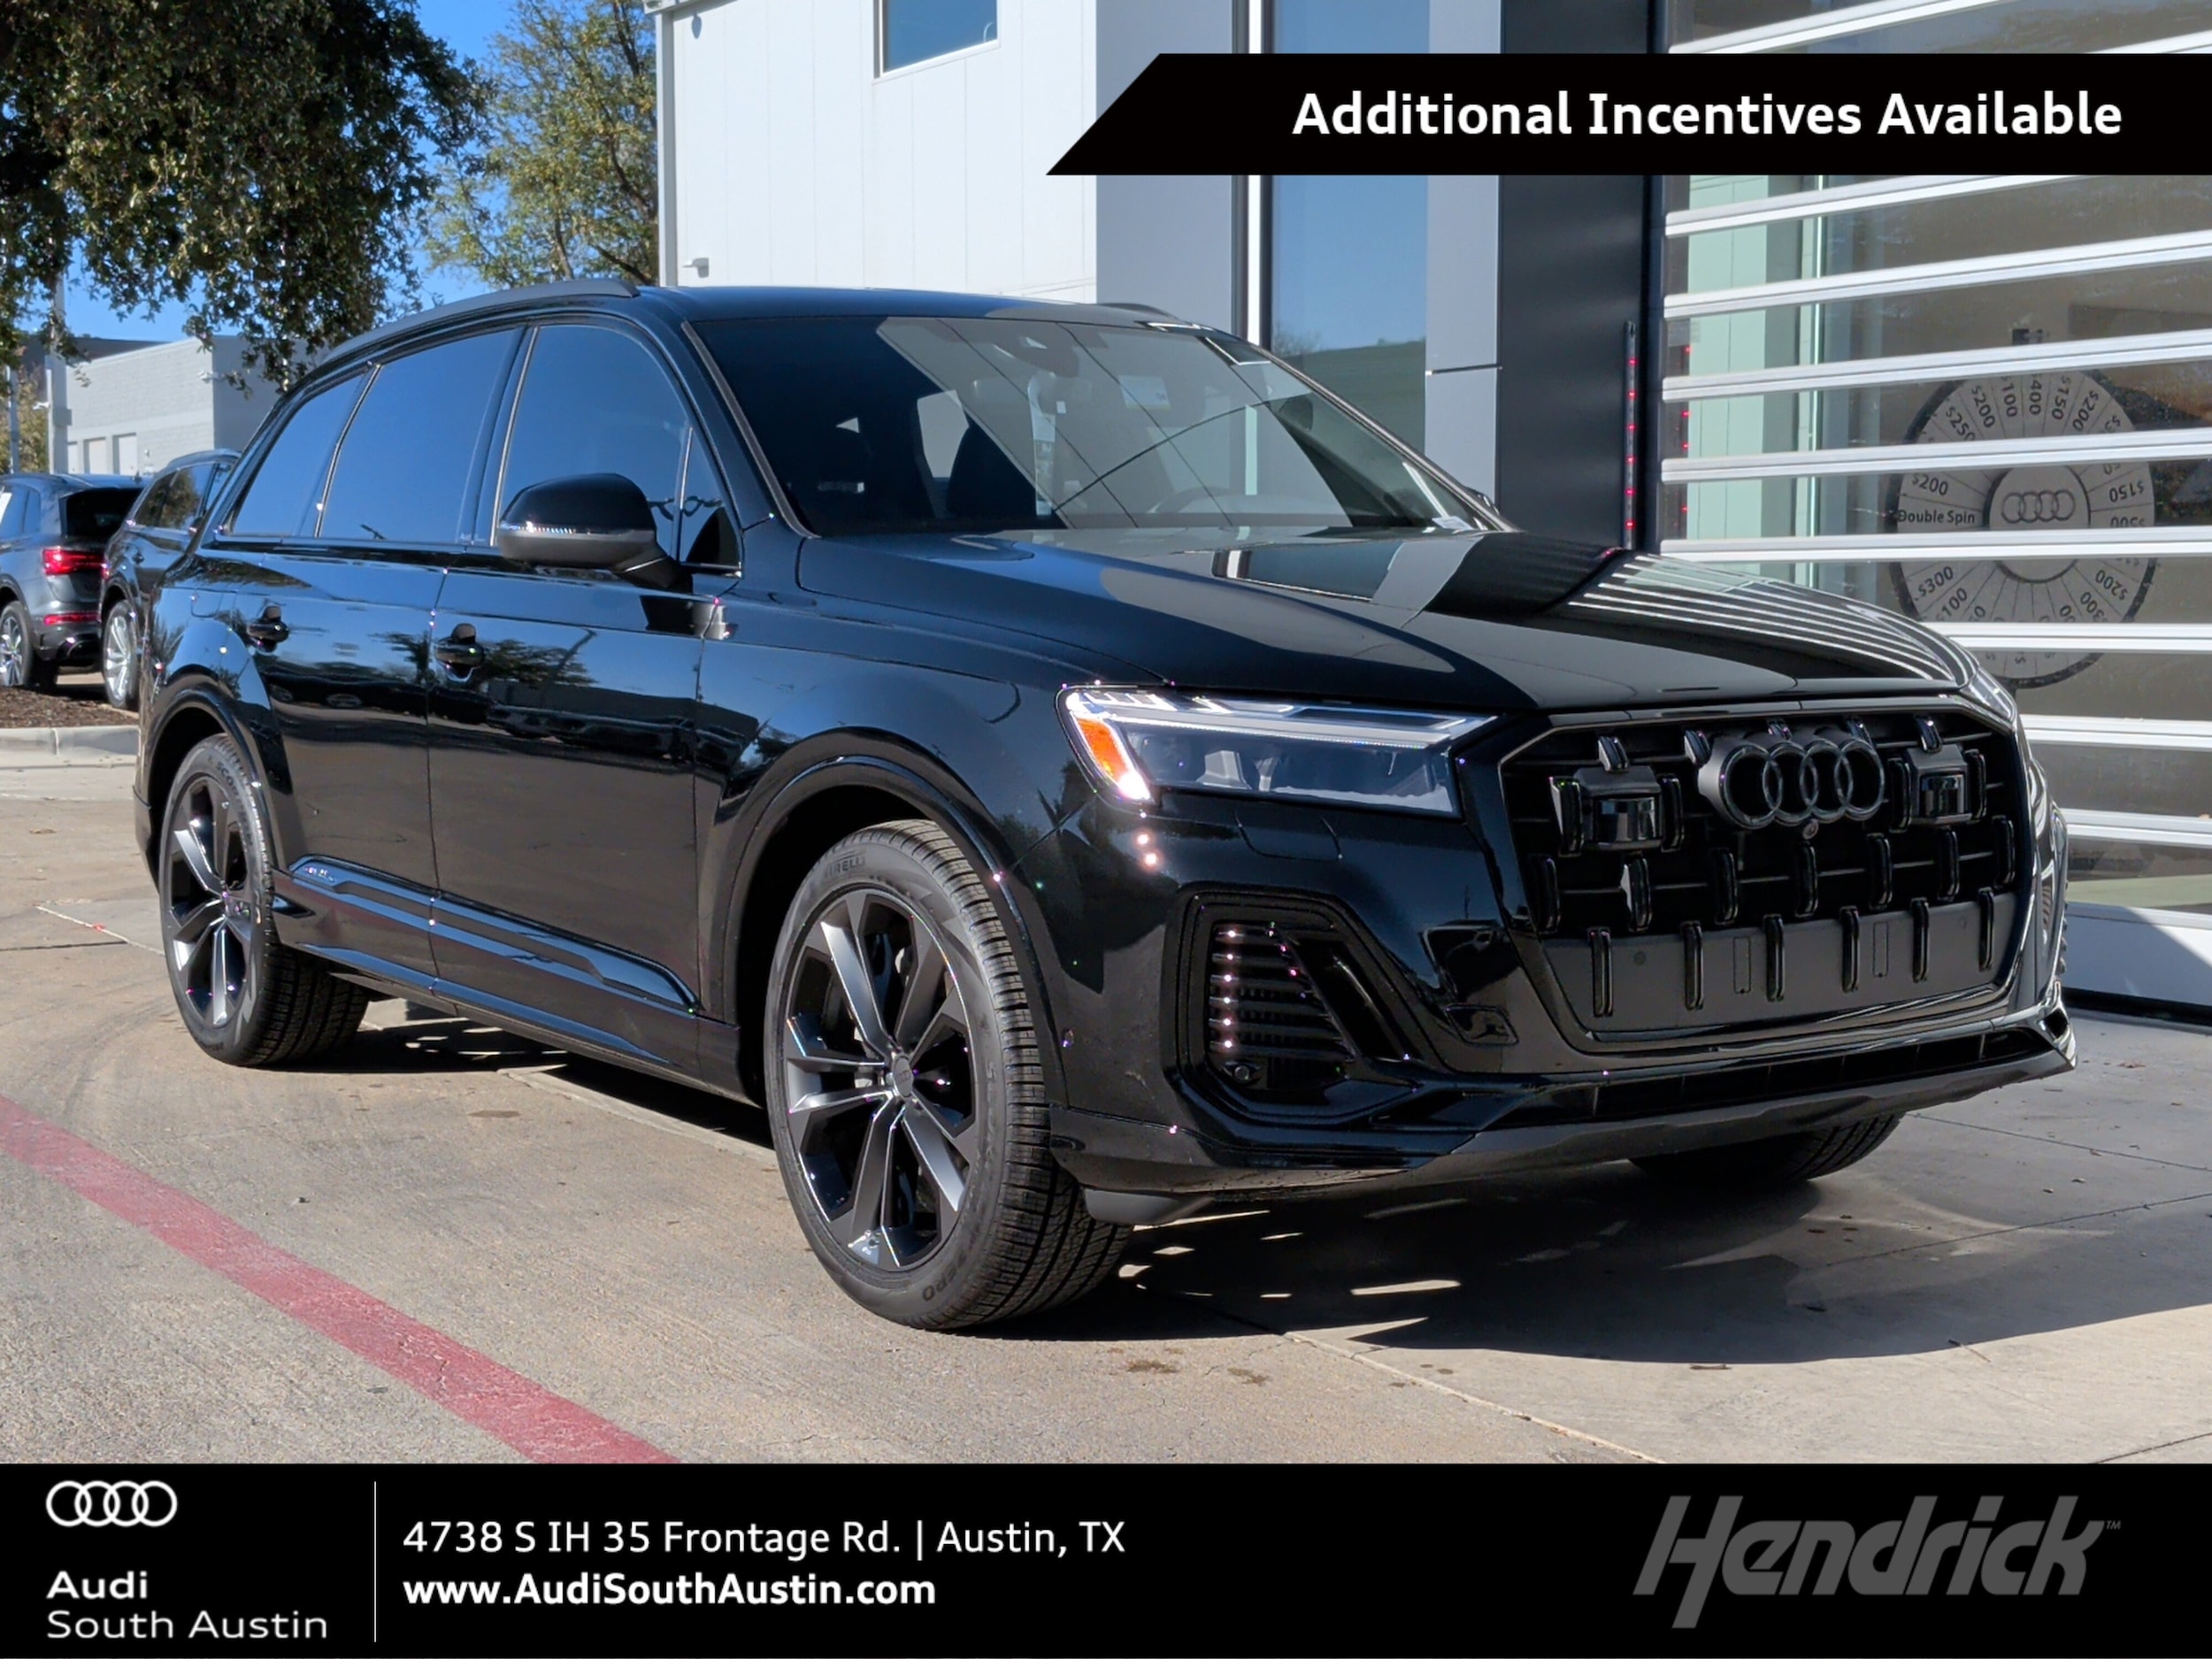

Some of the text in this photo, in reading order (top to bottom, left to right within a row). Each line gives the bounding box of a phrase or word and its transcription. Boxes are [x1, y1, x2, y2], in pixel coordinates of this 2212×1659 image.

[1971, 385, 1995, 428] $200
[2052, 375, 2071, 420] $150
[2072, 390, 2099, 431] $200
[1911, 472, 1949, 496] $200
[2109, 479, 2145, 503] $150
[1897, 509, 1976, 525] Double Spin
[1917, 565, 1954, 597] $300
[2095, 569, 2128, 601] $200
[2080, 591, 2108, 622] 300
